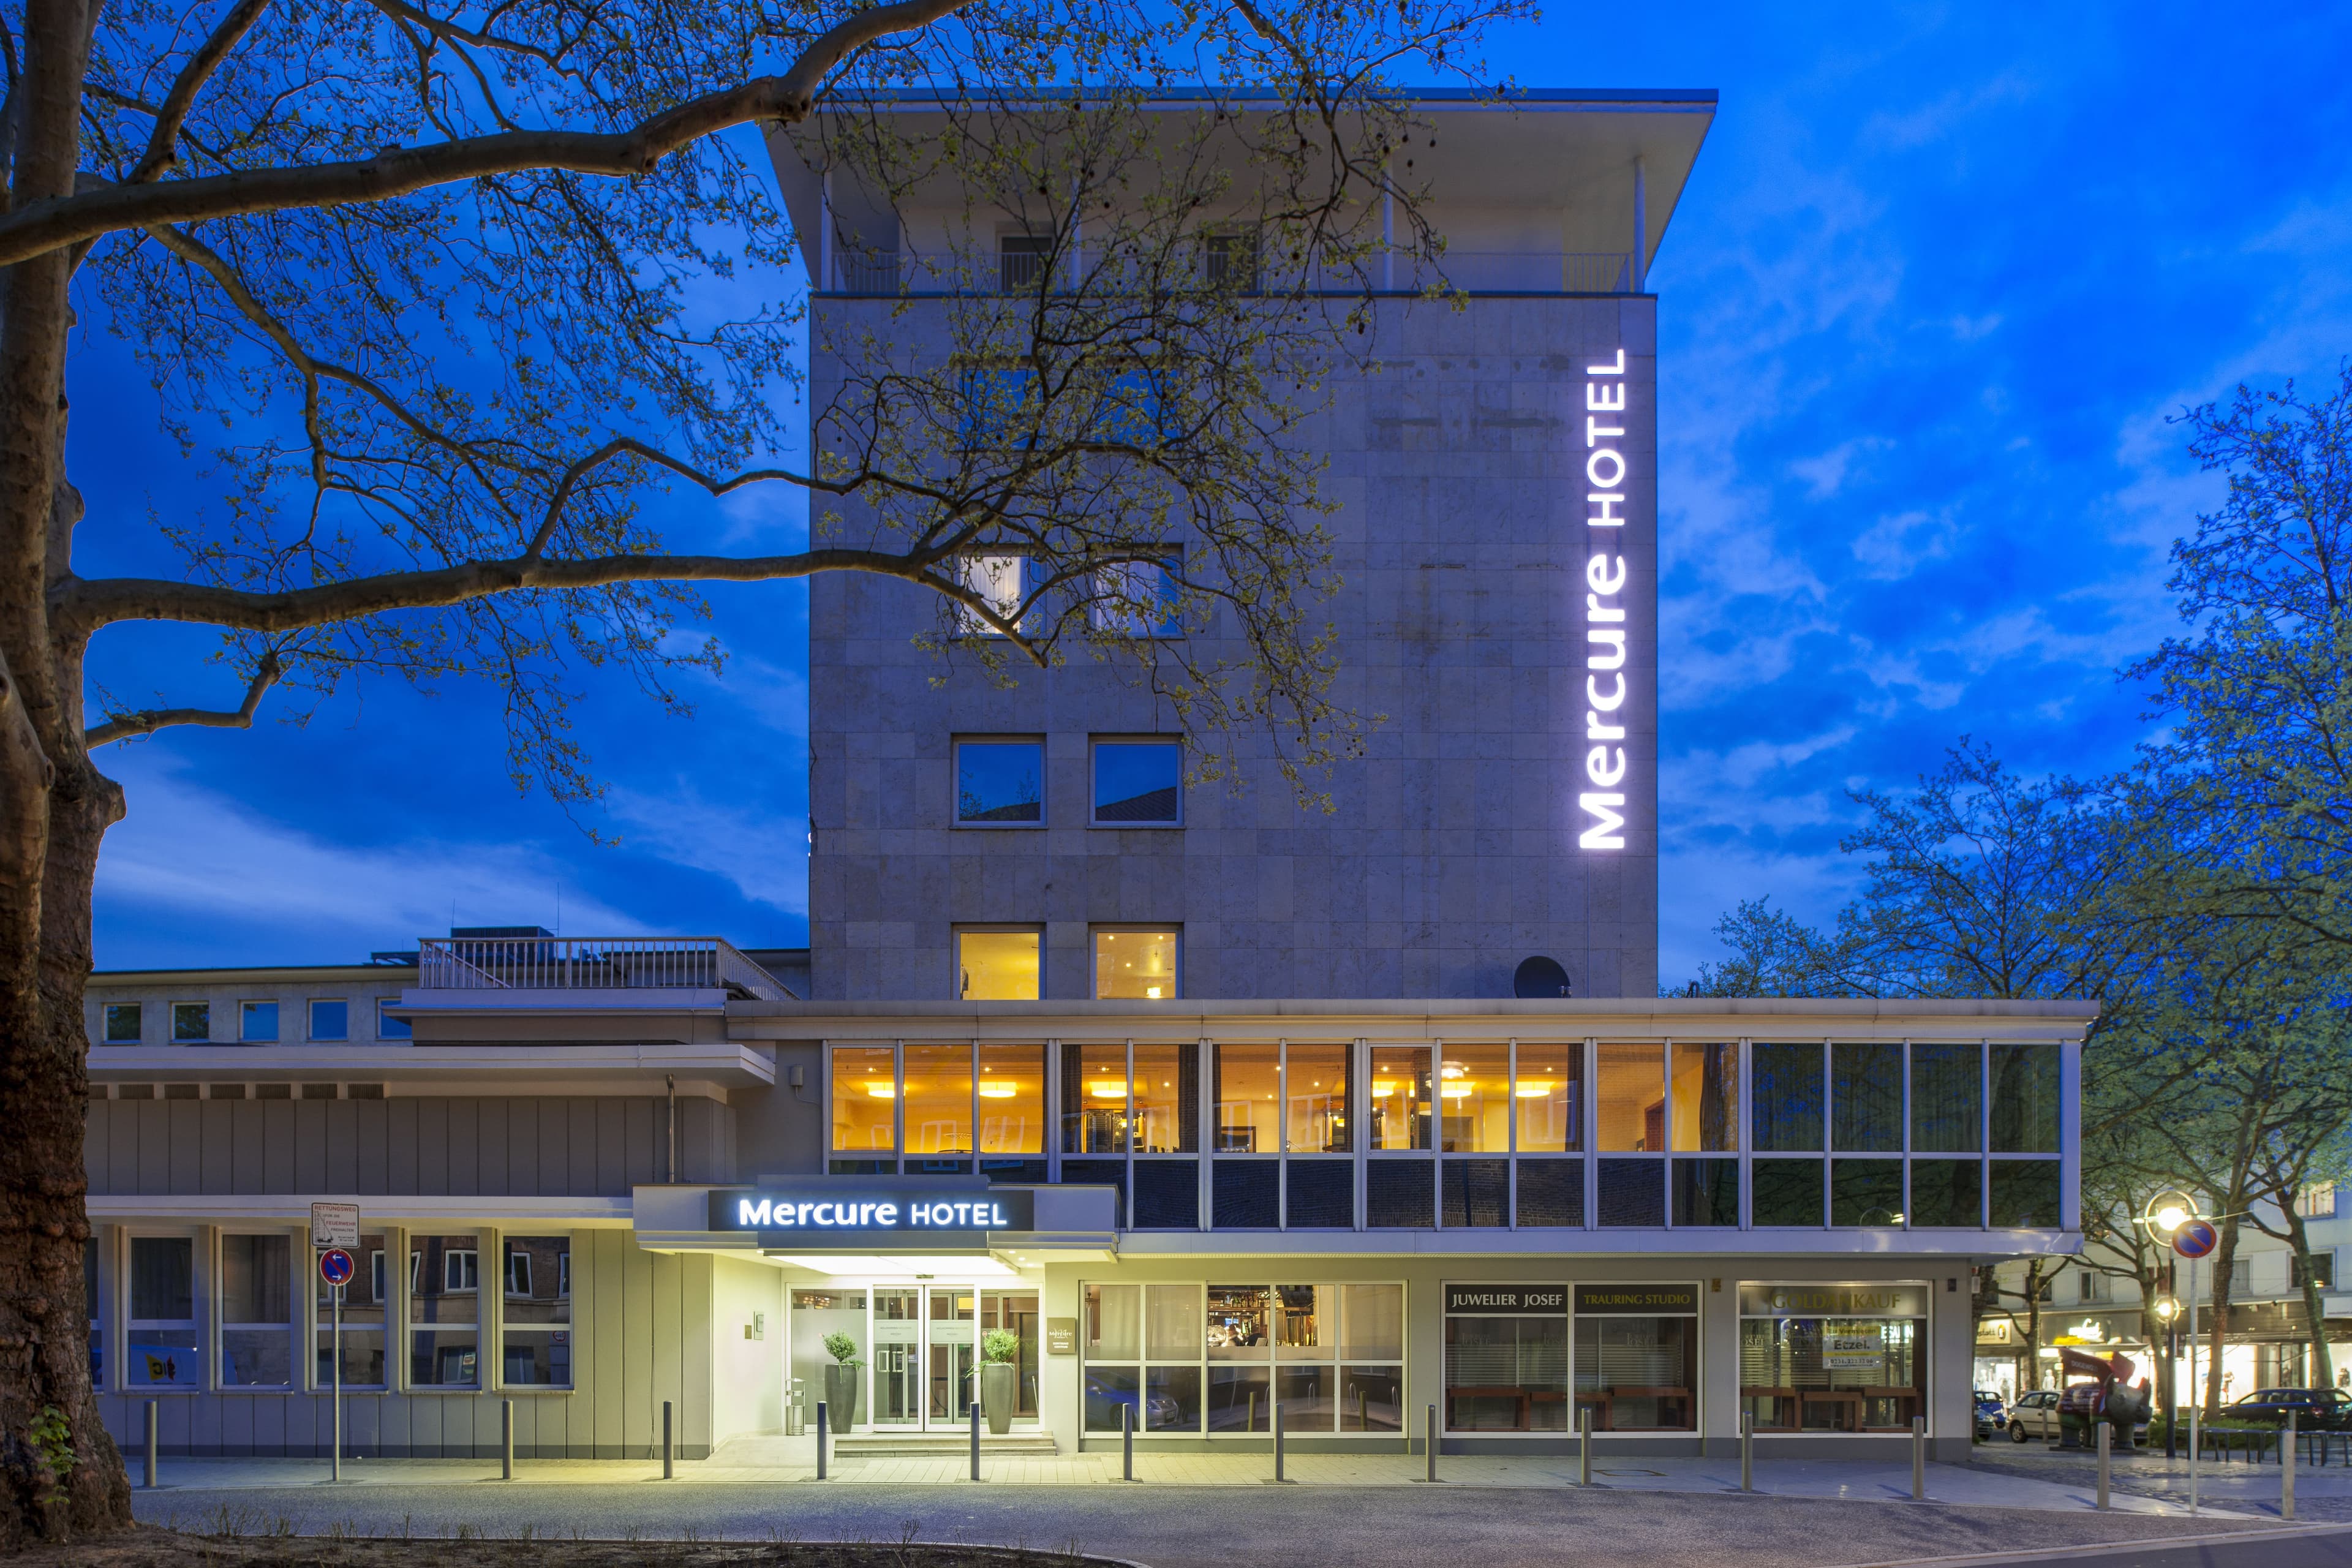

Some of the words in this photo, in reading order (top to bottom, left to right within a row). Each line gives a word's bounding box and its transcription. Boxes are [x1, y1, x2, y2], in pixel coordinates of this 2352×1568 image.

[1587, 349, 1626, 526] HOTEL
[1580, 554, 1626, 849] Mercure
[739, 1199, 898, 1225] Mercure
[911, 1203, 1008, 1225] HOTEL
[1452, 1294, 1517, 1308] JUWELIER
[1523, 1294, 1562, 1308] JOSEF
[1583, 1294, 1642, 1305] TRAURING
[1645, 1294, 1691, 1305] STUDIO
[1771, 1293, 1901, 1309] GOLDANKAUF
[1833, 1340, 1871, 1350] Etzel.
